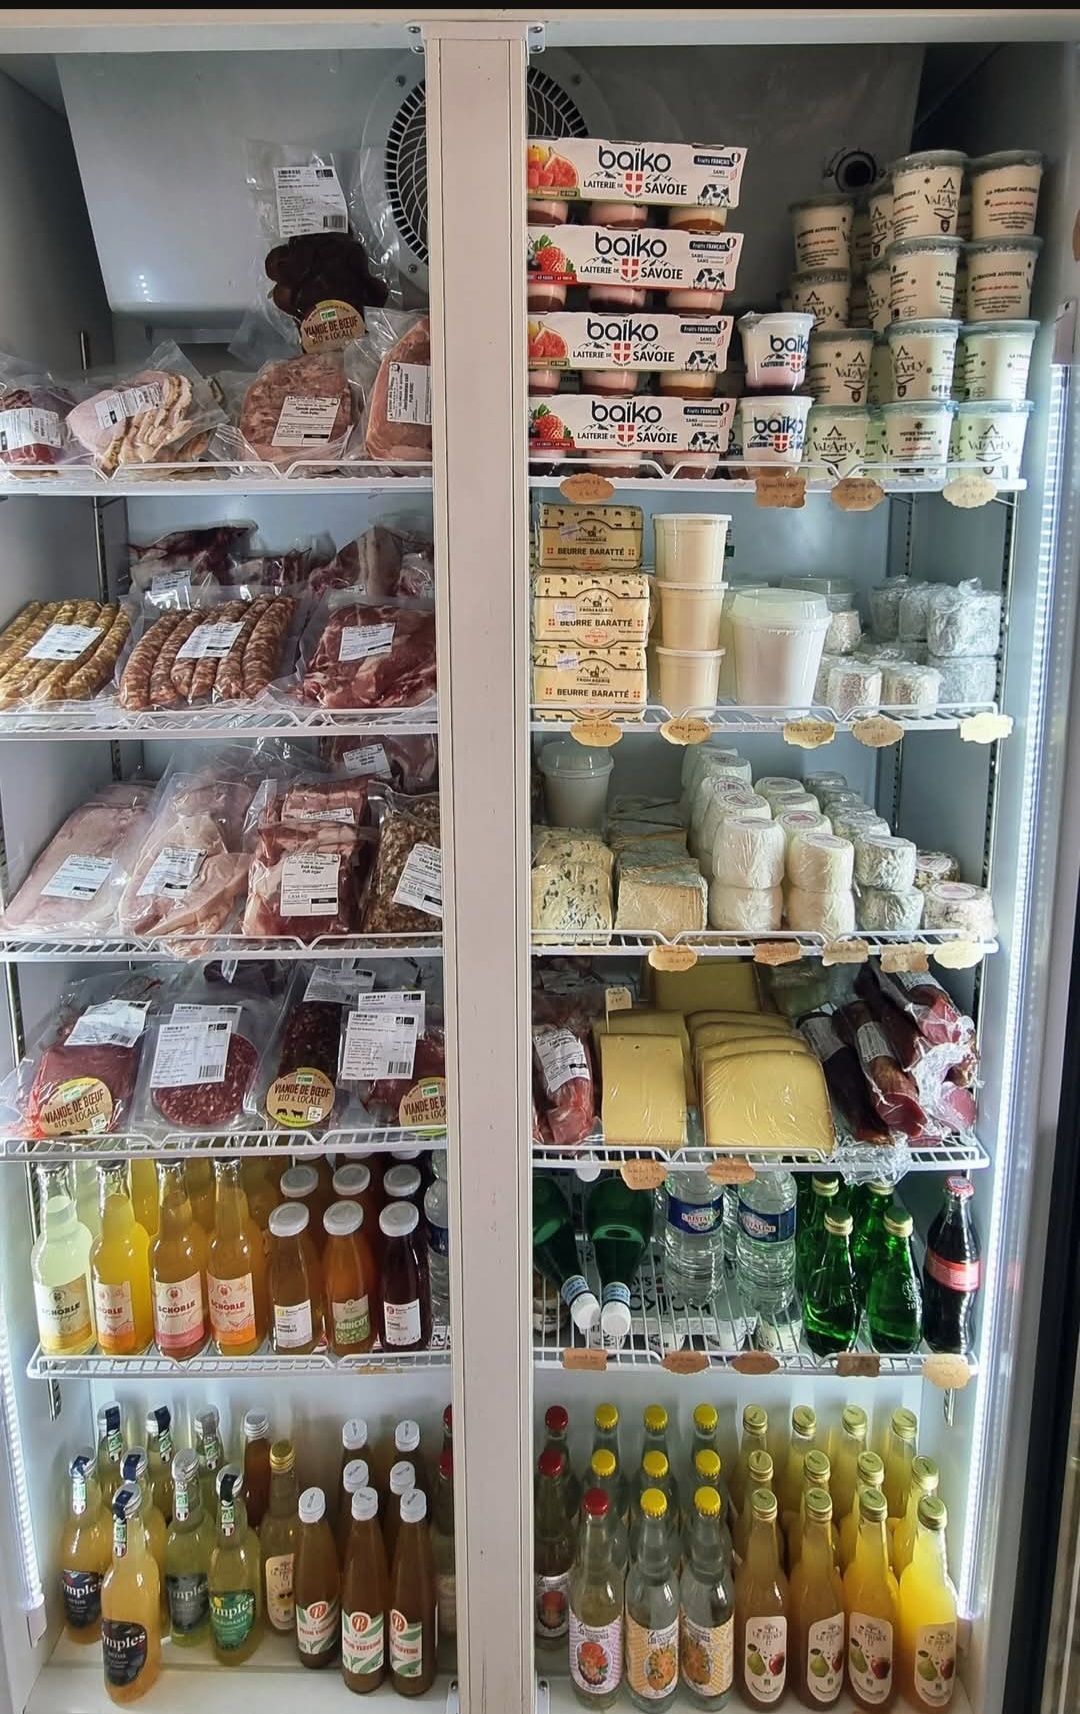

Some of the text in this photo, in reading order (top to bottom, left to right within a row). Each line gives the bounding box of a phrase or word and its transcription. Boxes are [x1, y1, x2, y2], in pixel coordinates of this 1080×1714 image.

[599, 145, 671, 172] baïko
[584, 180, 616, 189] LAITERIE
[645, 183, 687, 196] SAVOIE
[595, 232, 667, 258] baïko
[580, 266, 612, 274] LAITERIE
[641, 267, 683, 280] SAVOIE
[304, 322, 329, 337] VIANDE
[329, 320, 338, 331] DE
[587, 318, 659, 341] baïko
[573, 351, 605, 359] LAITERIE
[633, 351, 675, 362] SAVOIE
[591, 401, 662, 423] baïko
[754, 416, 804, 433] baïko
[577, 432, 609, 440] LAITERIE
[636, 431, 678, 443] SAVOIE
[557, 547, 625, 556] BEURRE BARATTÉ
[560, 618, 633, 627] BEURRE BARATTÉ
[557, 688, 629, 698] BEURRE BARATTÉ
[275, 1084, 300, 1094] VIANDE
[300, 1085, 310, 1095] DE
[298, 1095, 321, 1105] LOCALE
[404, 1099, 429, 1115] VIANDE
[430, 1097, 440, 1110] DE
[45, 1103, 72, 1123] VIANDE
[72, 1099, 83, 1112] DE
[54, 1119, 67, 1128] BIO
[75, 1104, 100, 1122] LOCALE
[158, 1300, 196, 1314] SCHORLE
[211, 1299, 245, 1311] SCHORLE
